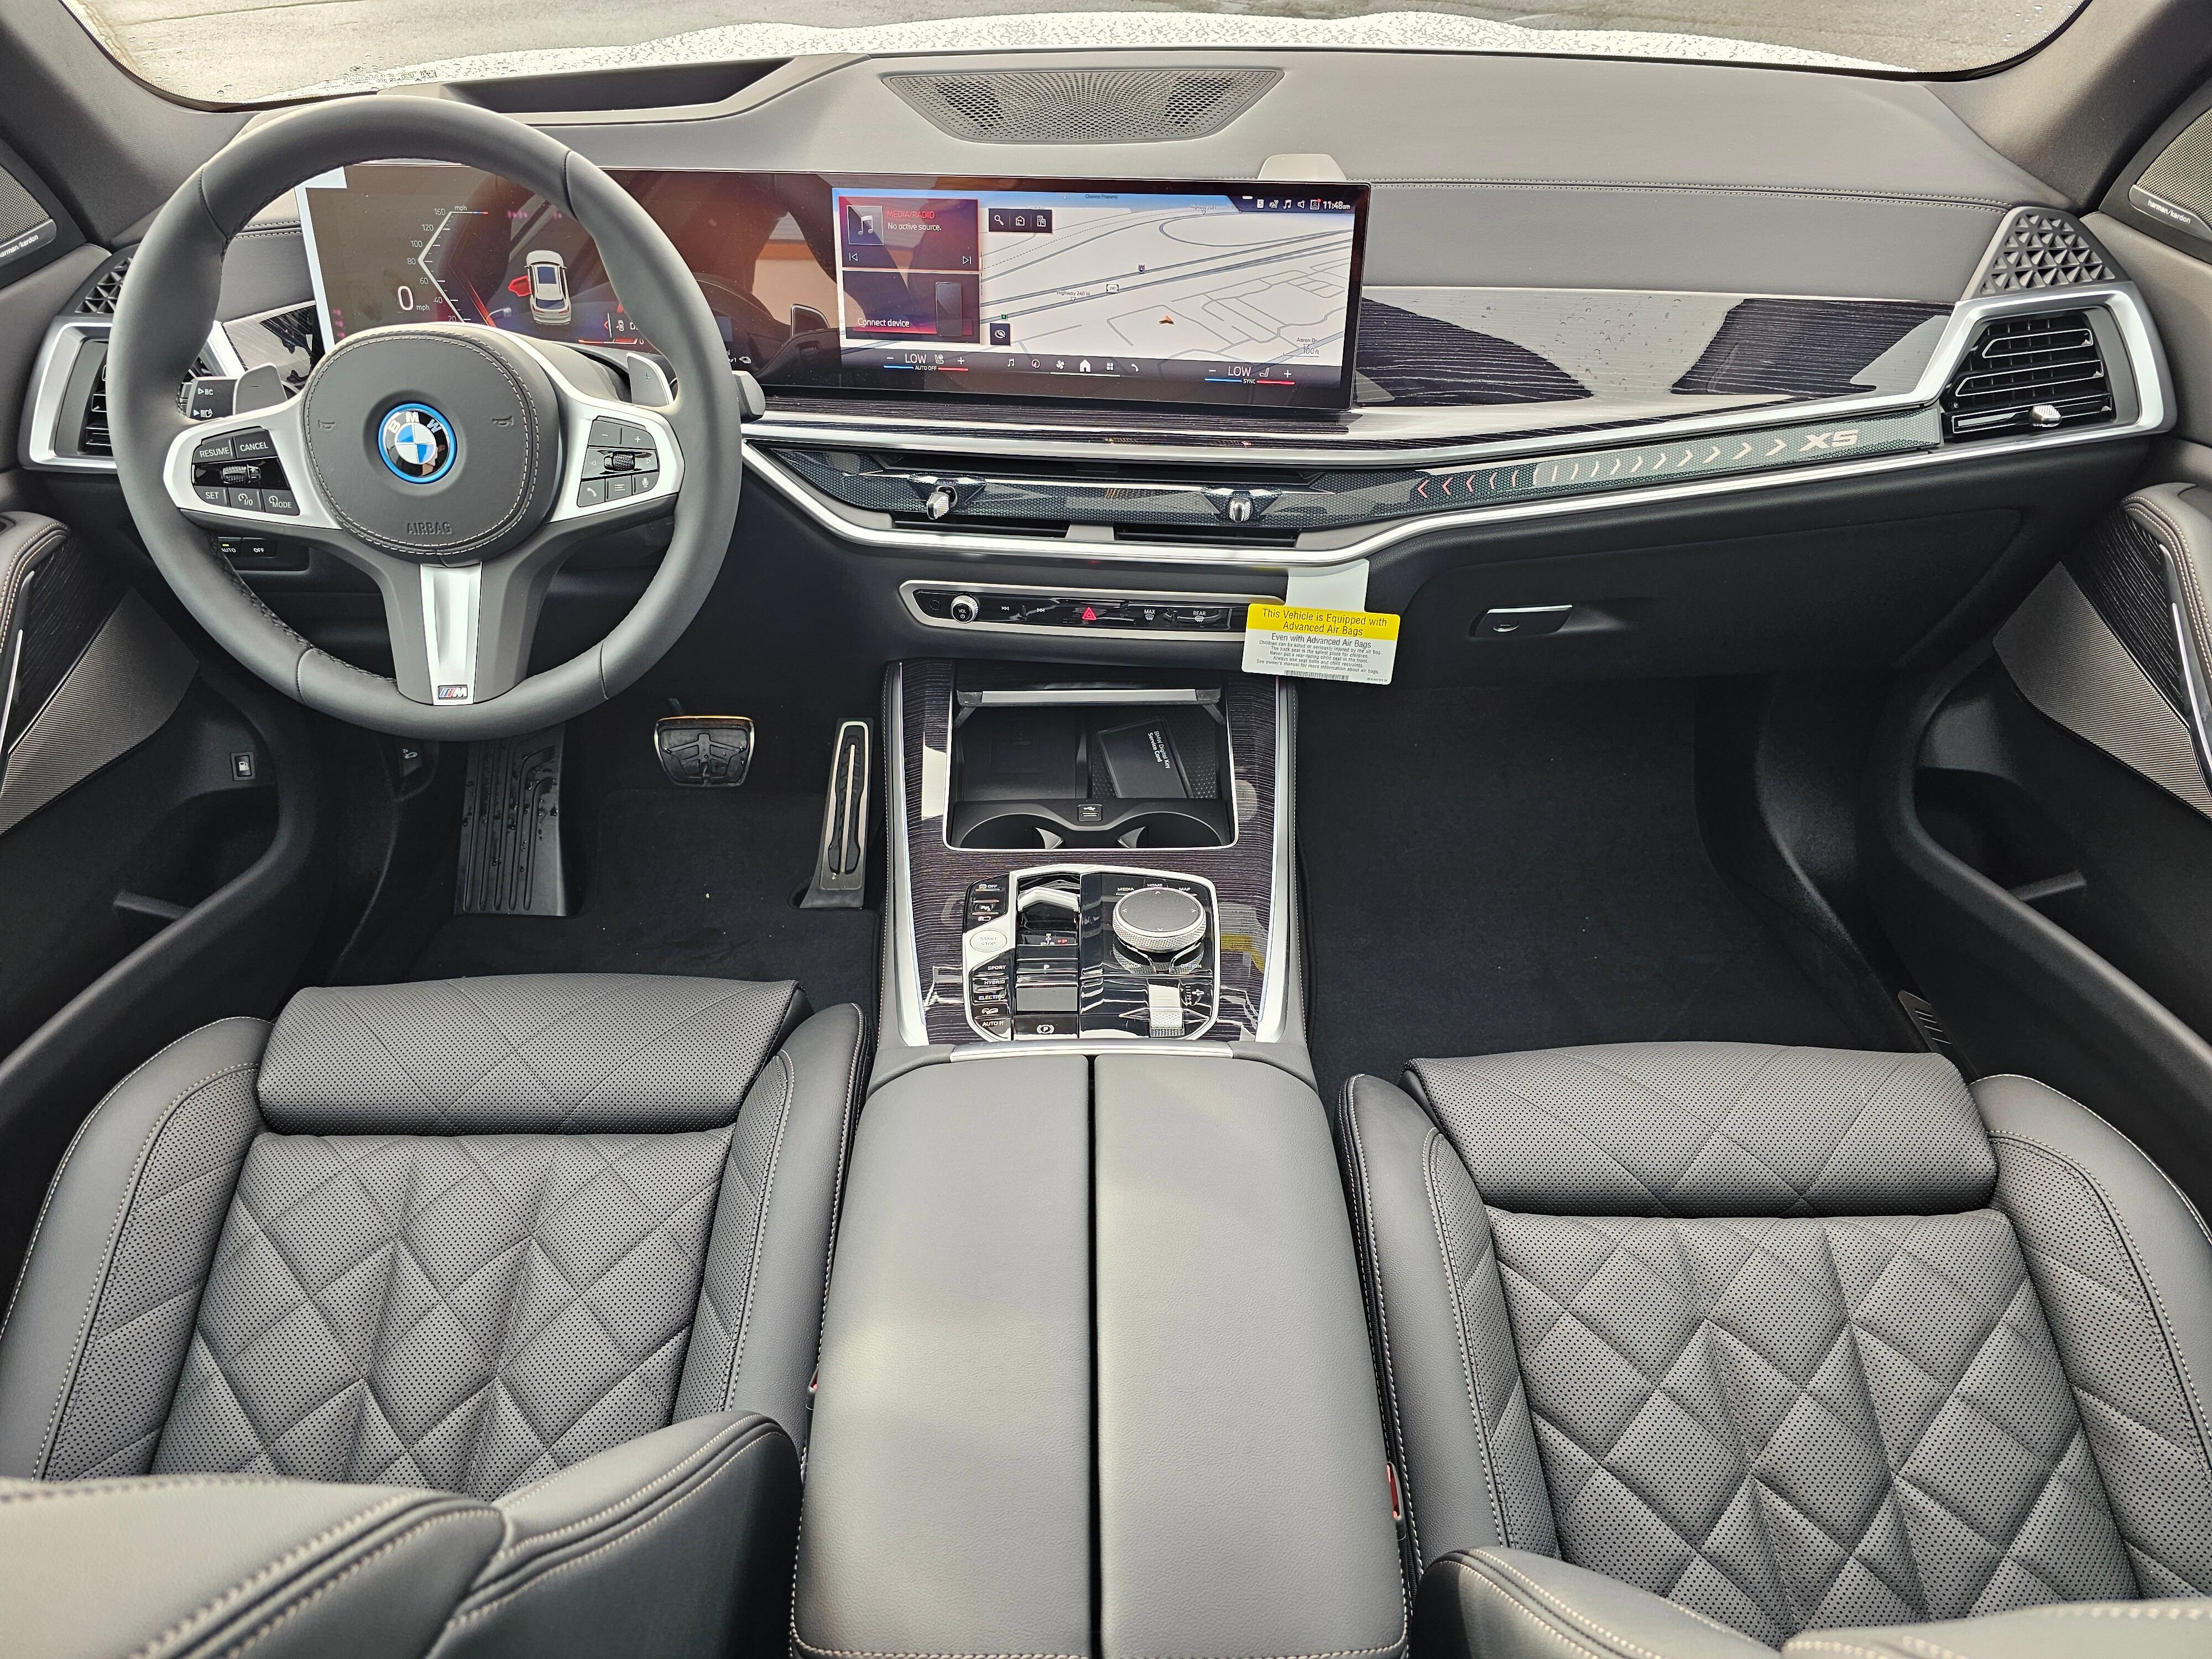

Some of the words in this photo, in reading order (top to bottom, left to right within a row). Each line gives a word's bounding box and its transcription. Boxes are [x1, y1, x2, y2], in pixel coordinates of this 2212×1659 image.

[887, 211, 935, 220] MEDIA/RADIO
[2148, 199, 2190, 224] harman/kardon
[398, 285, 414, 311] 0
[858, 318, 886, 326] Connect
[887, 319, 910, 327] device
[905, 353, 927, 364] LOW
[1228, 366, 1251, 377] LOW
[388, 411, 441, 433] BMW
[240, 441, 269, 452] CANCEL
[1799, 429, 1859, 452] X5
[200, 447, 230, 457] RESUME
[406, 521, 452, 535] AIRBAG
[1262, 608, 1280, 618] This
[1283, 609, 1313, 620] Vehicle
[1316, 612, 1323, 622] is
[1326, 613, 1366, 625] Equipped
[1369, 617, 1387, 627] with
[1283, 621, 1324, 632] Advanced
[1327, 624, 1339, 634] Air
[1342, 625, 1363, 637] Bags
[1272, 633, 1288, 641] Even
[1290, 634, 1305, 643] with
[1306, 635, 1340, 646] Advanced
[1354, 640, 1371, 649] Bags
[1147, 732, 1157, 751] Service
[1154, 750, 1163, 763] Card
[1154, 731, 1163, 744] BMW
[1159, 744, 1168, 760] Digital
